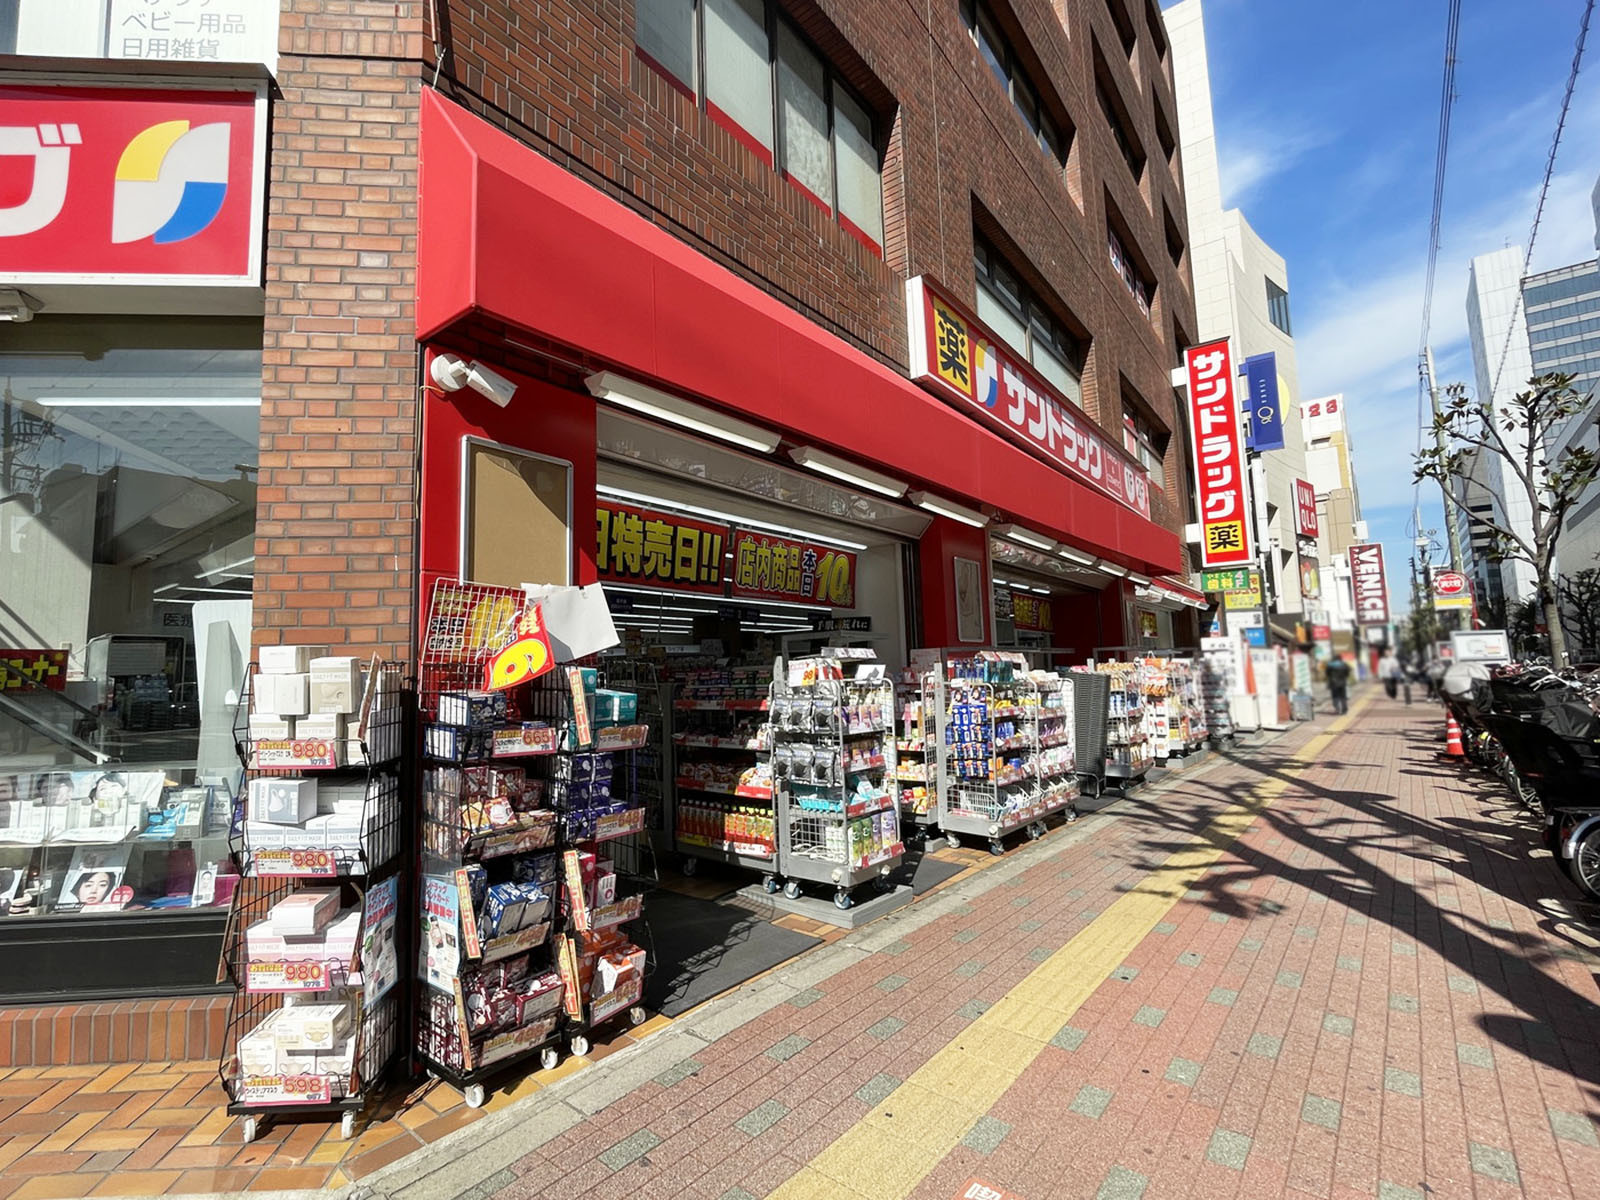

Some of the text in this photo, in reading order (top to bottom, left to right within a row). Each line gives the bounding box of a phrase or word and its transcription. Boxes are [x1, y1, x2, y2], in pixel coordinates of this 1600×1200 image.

[122, 12, 246, 34] ベビー用品
[122, 38, 220, 59] 日用雑貨
[936, 306, 969, 386] 薬
[1192, 350, 1236, 520] サンドラッグ
[1299, 485, 1315, 510] UNI
[1301, 511, 1317, 534] QLO
[1209, 523, 1240, 550] 薬
[735, 537, 800, 592] 店内商品
[801, 549, 817, 597] 本日
[1358, 547, 1386, 621] VENICE
[523, 730, 549, 746] 665
[293, 742, 328, 758] 980
[293, 852, 328, 868] 980
[286, 965, 321, 981] 980
[285, 1078, 321, 1093] 598
